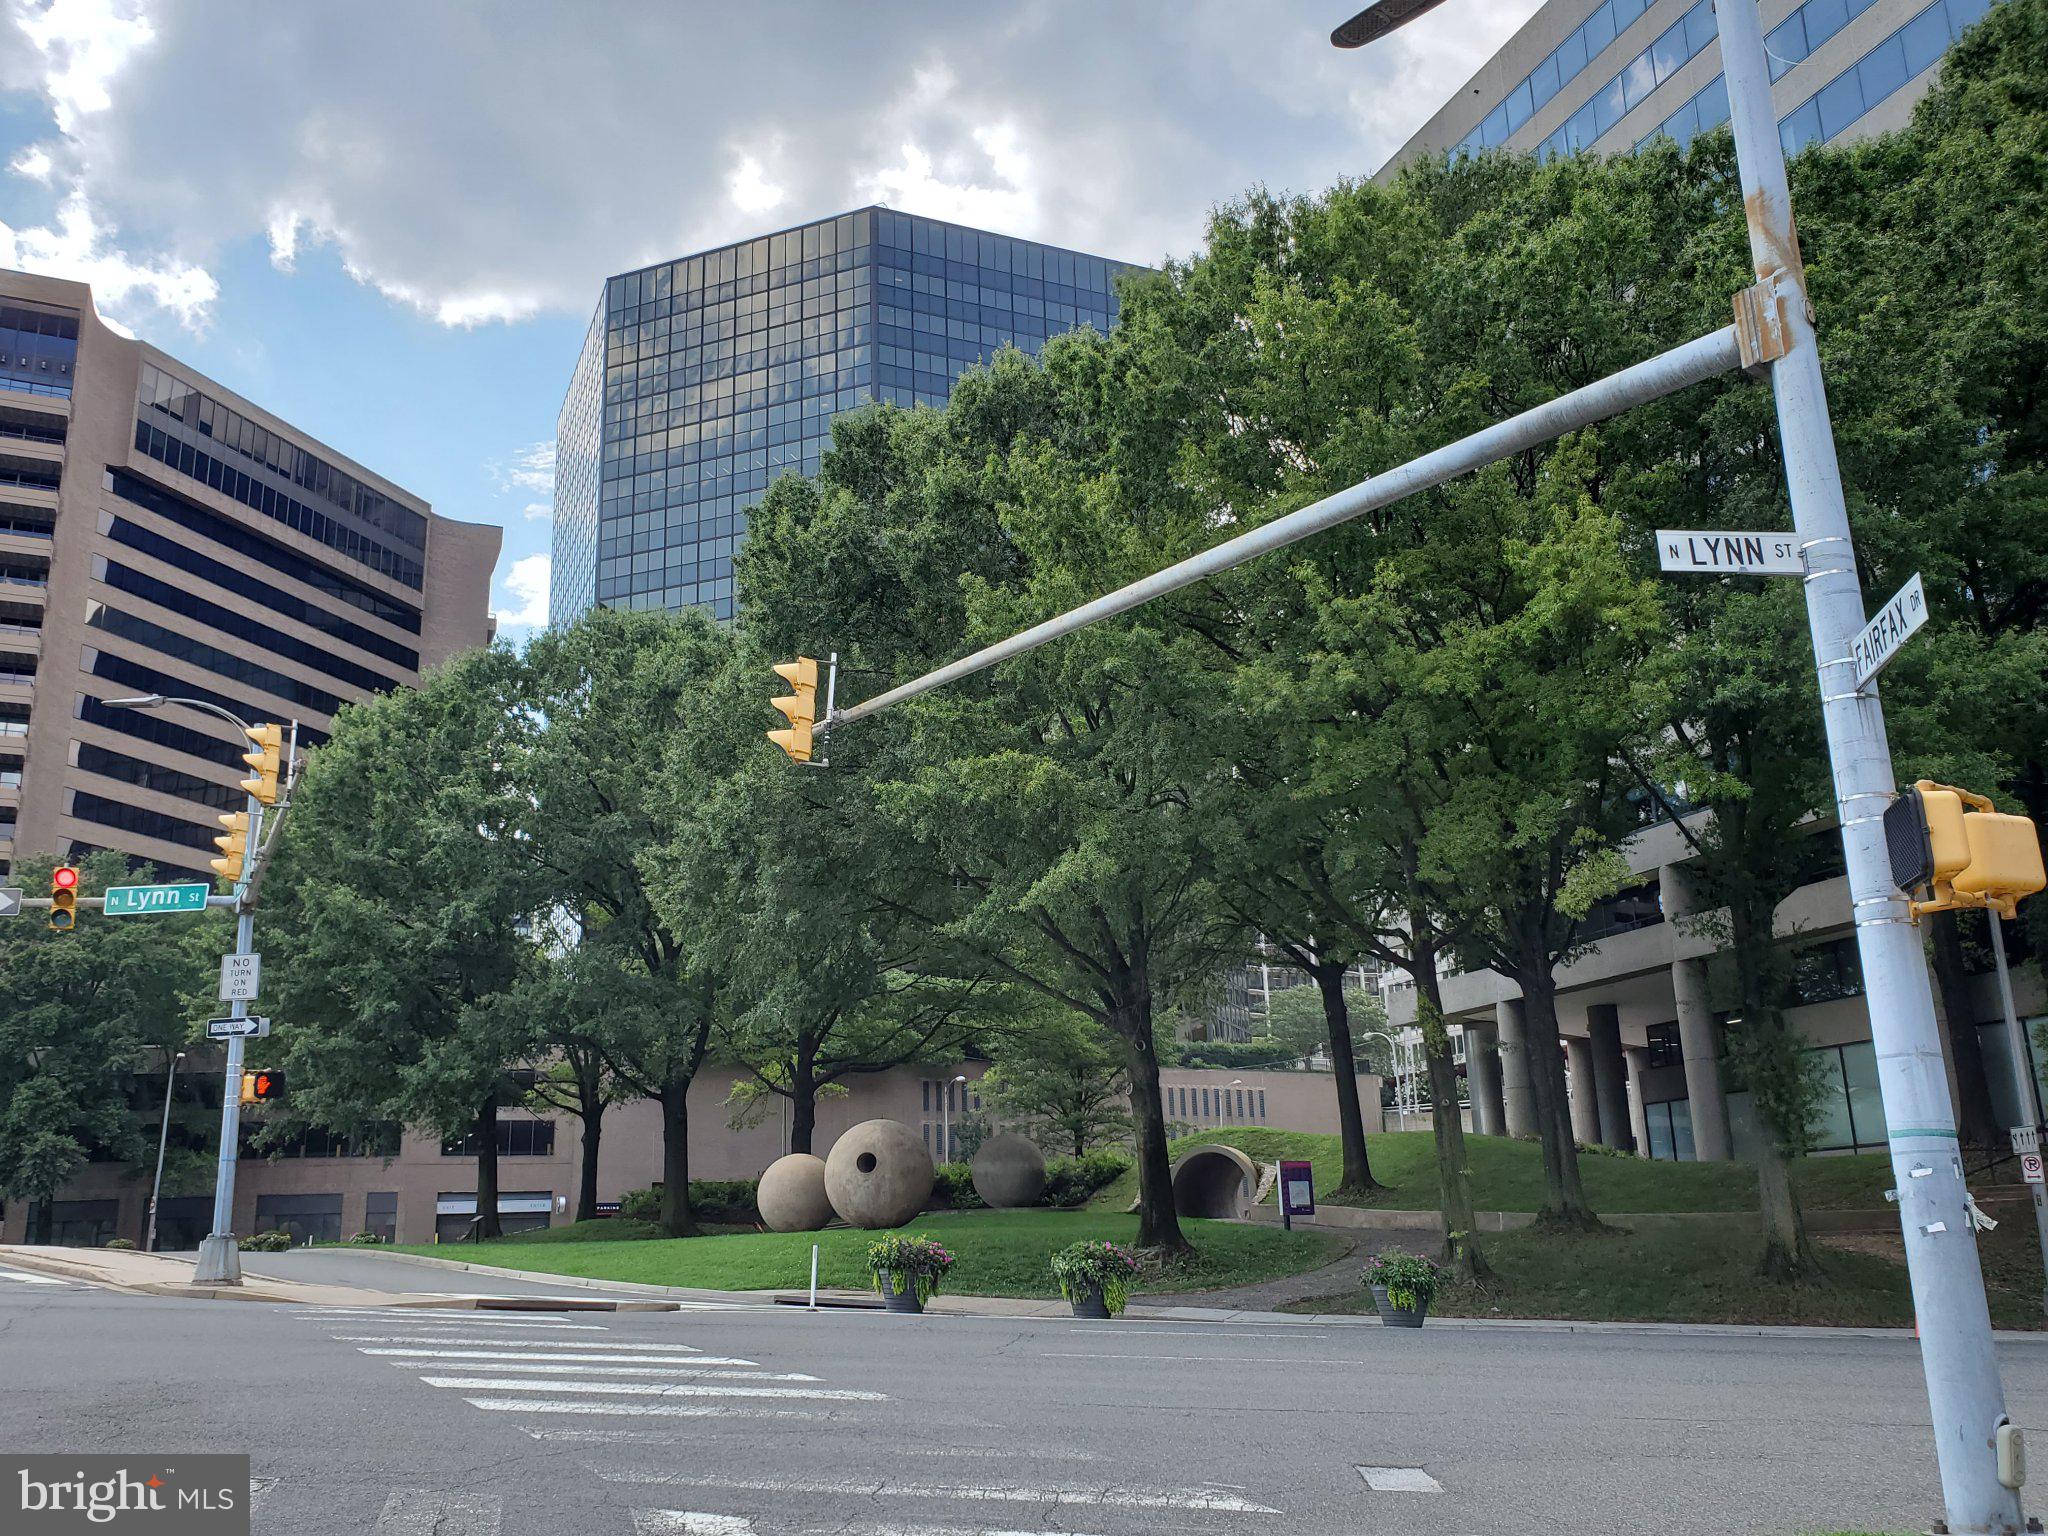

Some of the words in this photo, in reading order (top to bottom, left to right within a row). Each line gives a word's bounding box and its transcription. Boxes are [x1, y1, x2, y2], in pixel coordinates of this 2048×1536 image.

[1669, 544, 1680, 559] N
[1688, 537, 1765, 566] LYNN
[1774, 543, 1792, 558] ST
[1854, 597, 1908, 677] FAIRFAX
[1909, 590, 1921, 612] DR
[110, 896, 119, 906] N
[127, 889, 180, 910] Lynn
[188, 892, 200, 902] St
[232, 958, 250, 967] NO
[230, 969, 252, 977] TURN
[231, 988, 248, 996] RED
[213, 1024, 227, 1032] ONE
[229, 1022, 244, 1030] WAY
